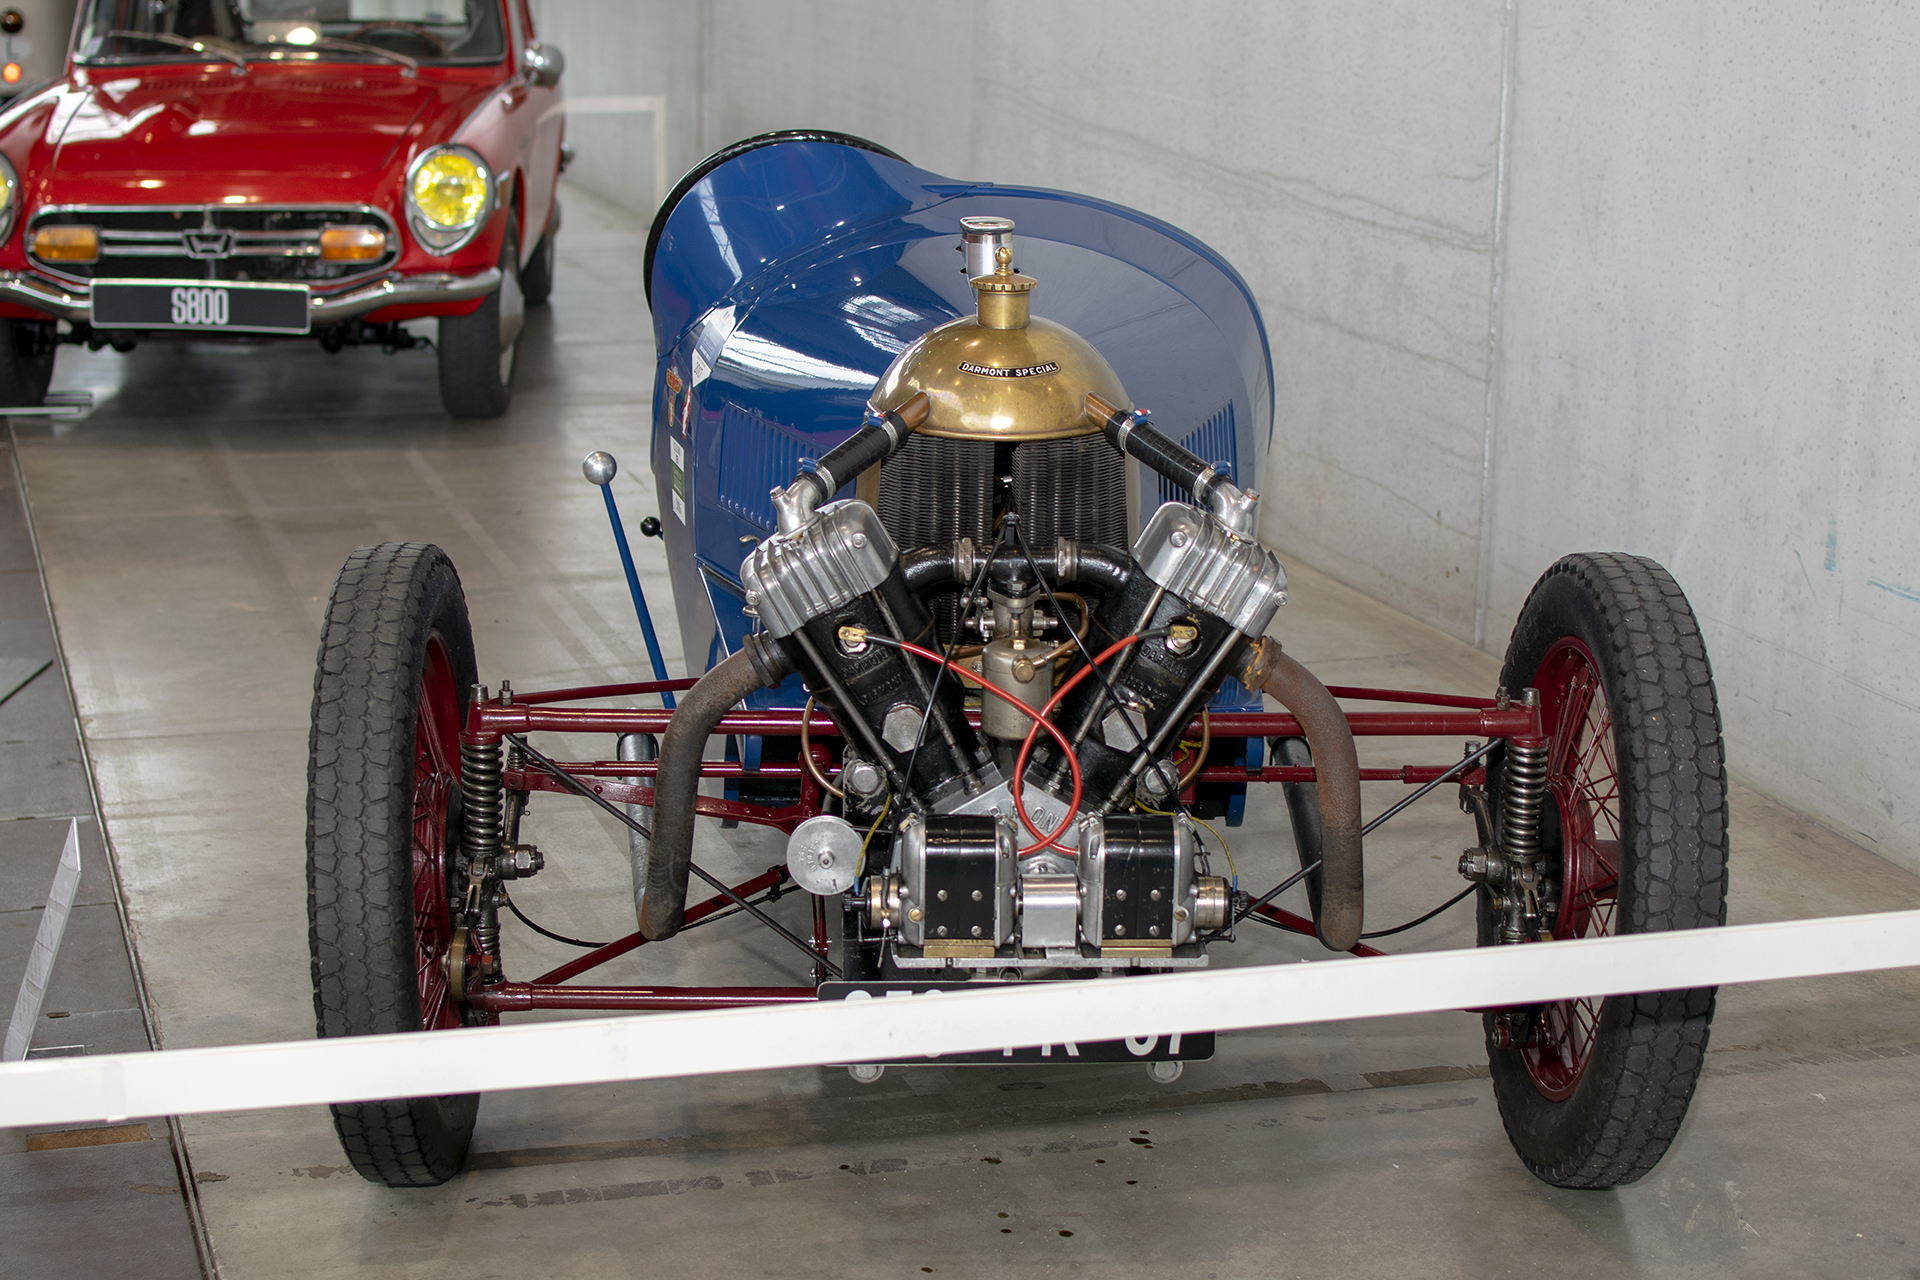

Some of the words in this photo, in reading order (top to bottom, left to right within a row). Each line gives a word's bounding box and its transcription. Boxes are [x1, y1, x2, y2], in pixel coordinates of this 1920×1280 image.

[171, 287, 229, 326] S800
[961, 362, 1010, 377] DARMONT
[1015, 363, 1057, 377] SPECIAL
